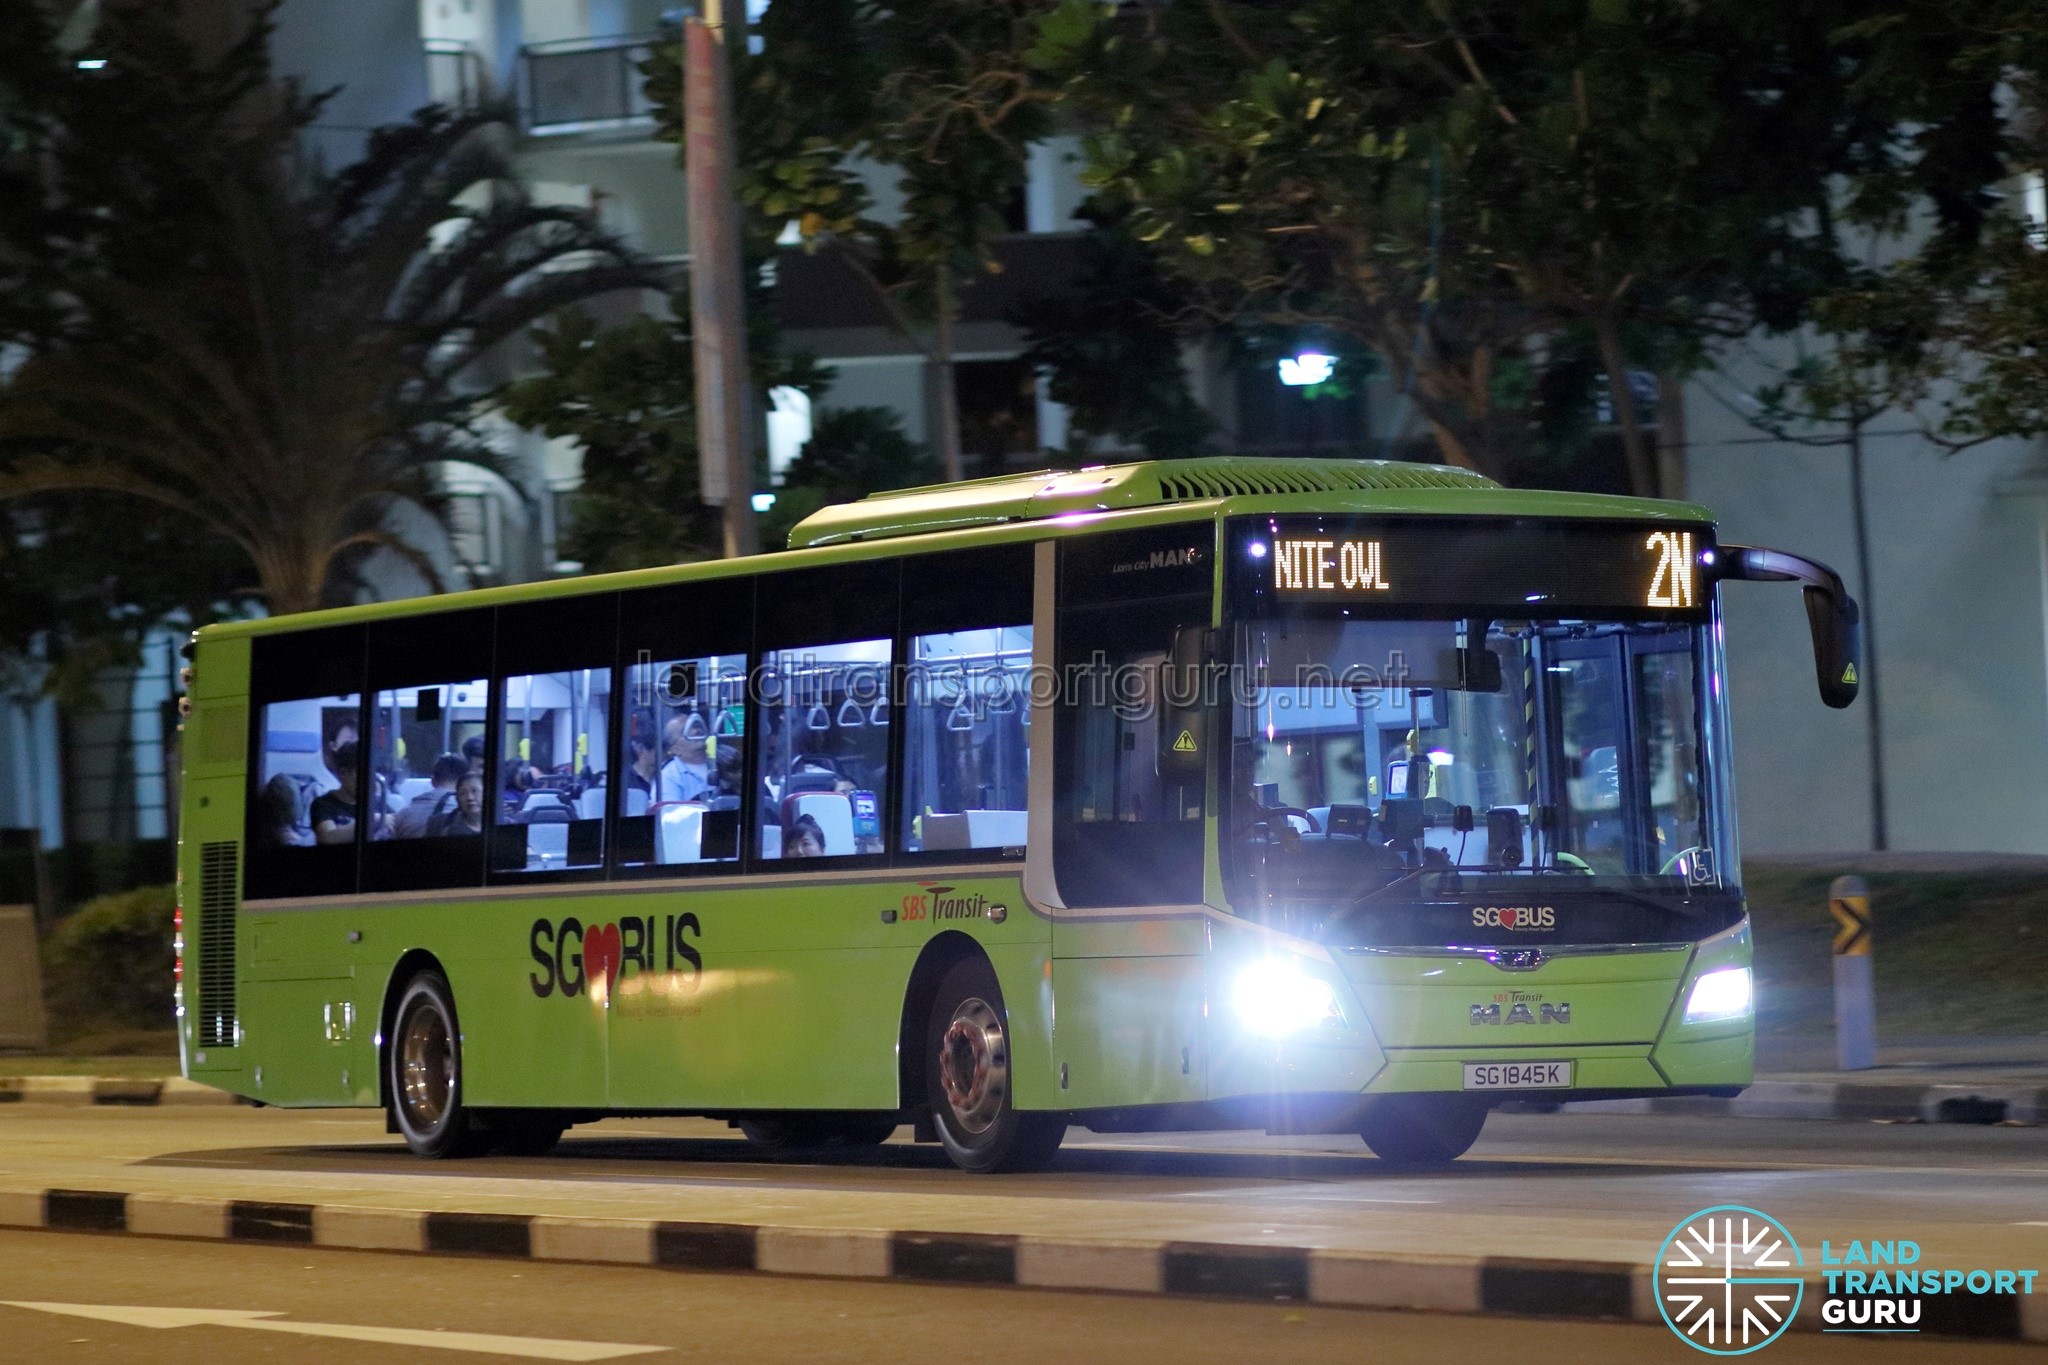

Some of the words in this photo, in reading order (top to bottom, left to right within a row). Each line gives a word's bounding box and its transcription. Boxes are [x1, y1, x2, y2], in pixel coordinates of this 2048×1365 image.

[1275, 541, 1334, 588] NITE
[1341, 541, 1389, 589] OWL
[1646, 532, 1692, 607] 2N
[902, 895, 928, 921] SBS
[926, 886, 988, 925] Transit
[1509, 991, 1543, 1002] Transit
[1470, 1003, 1570, 1025] MAN
[1475, 1065, 1559, 1085] SG1845K
